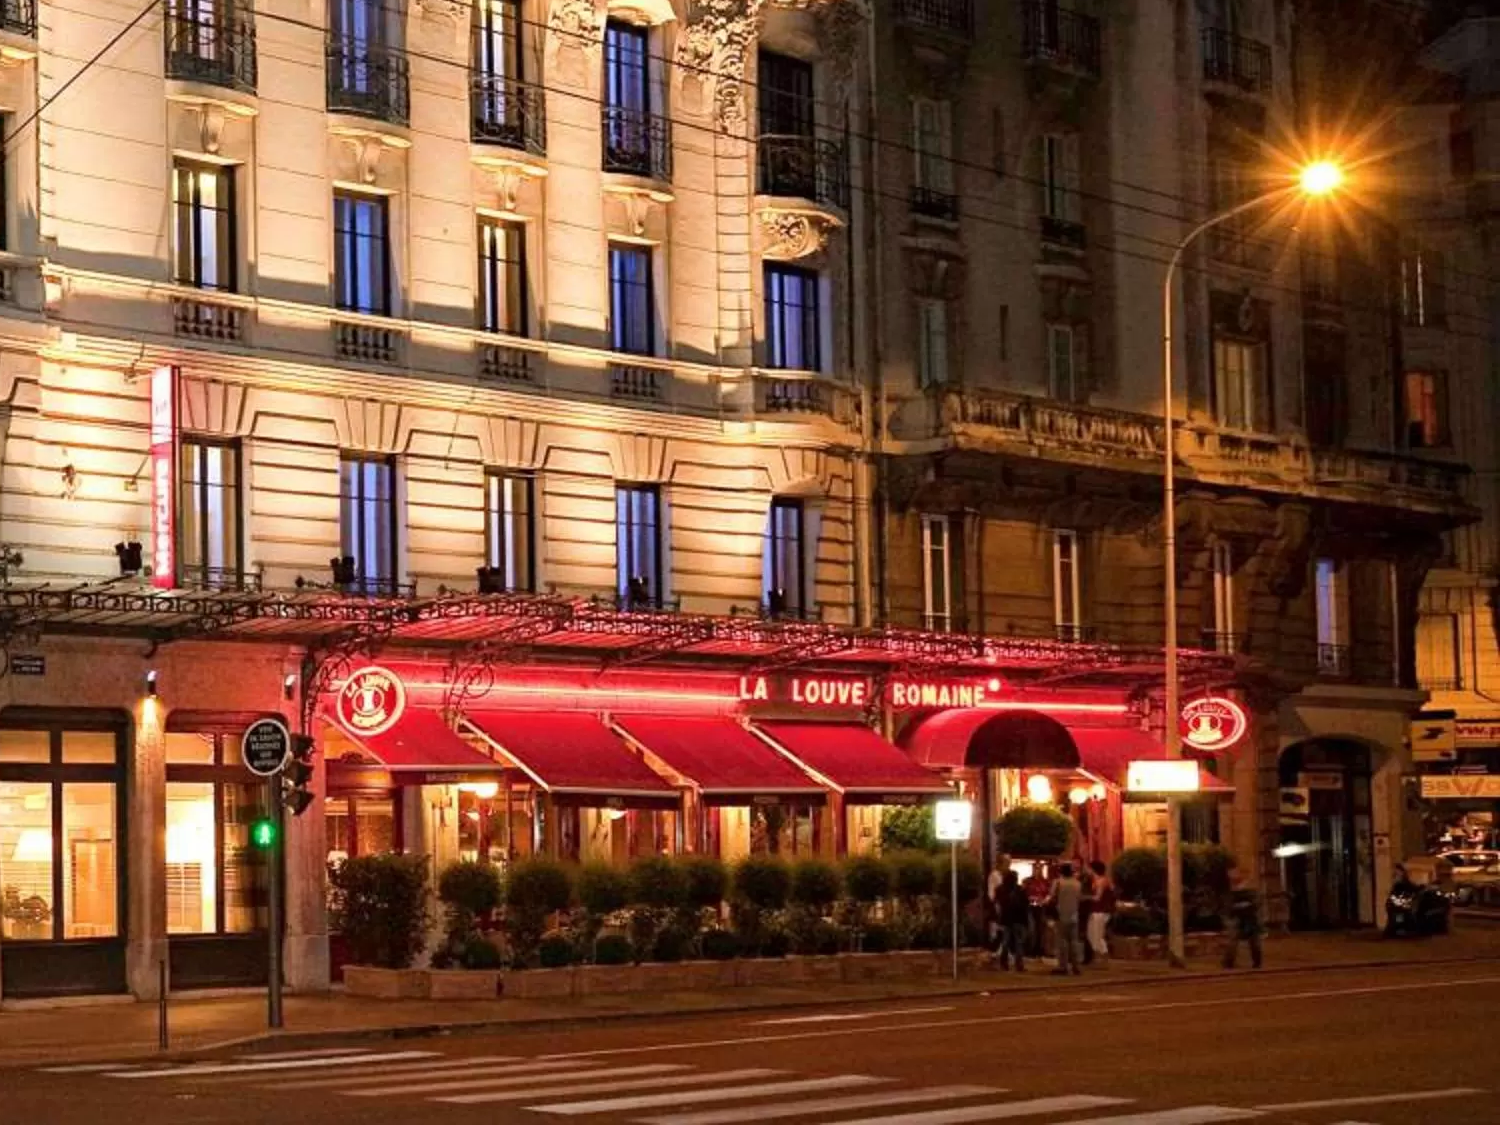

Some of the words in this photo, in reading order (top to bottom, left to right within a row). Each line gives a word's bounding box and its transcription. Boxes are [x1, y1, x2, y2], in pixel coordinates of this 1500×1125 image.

[739, 676, 769, 701] LA
[792, 678, 865, 705] LOUVE
[892, 682, 986, 709] ROMAINE
